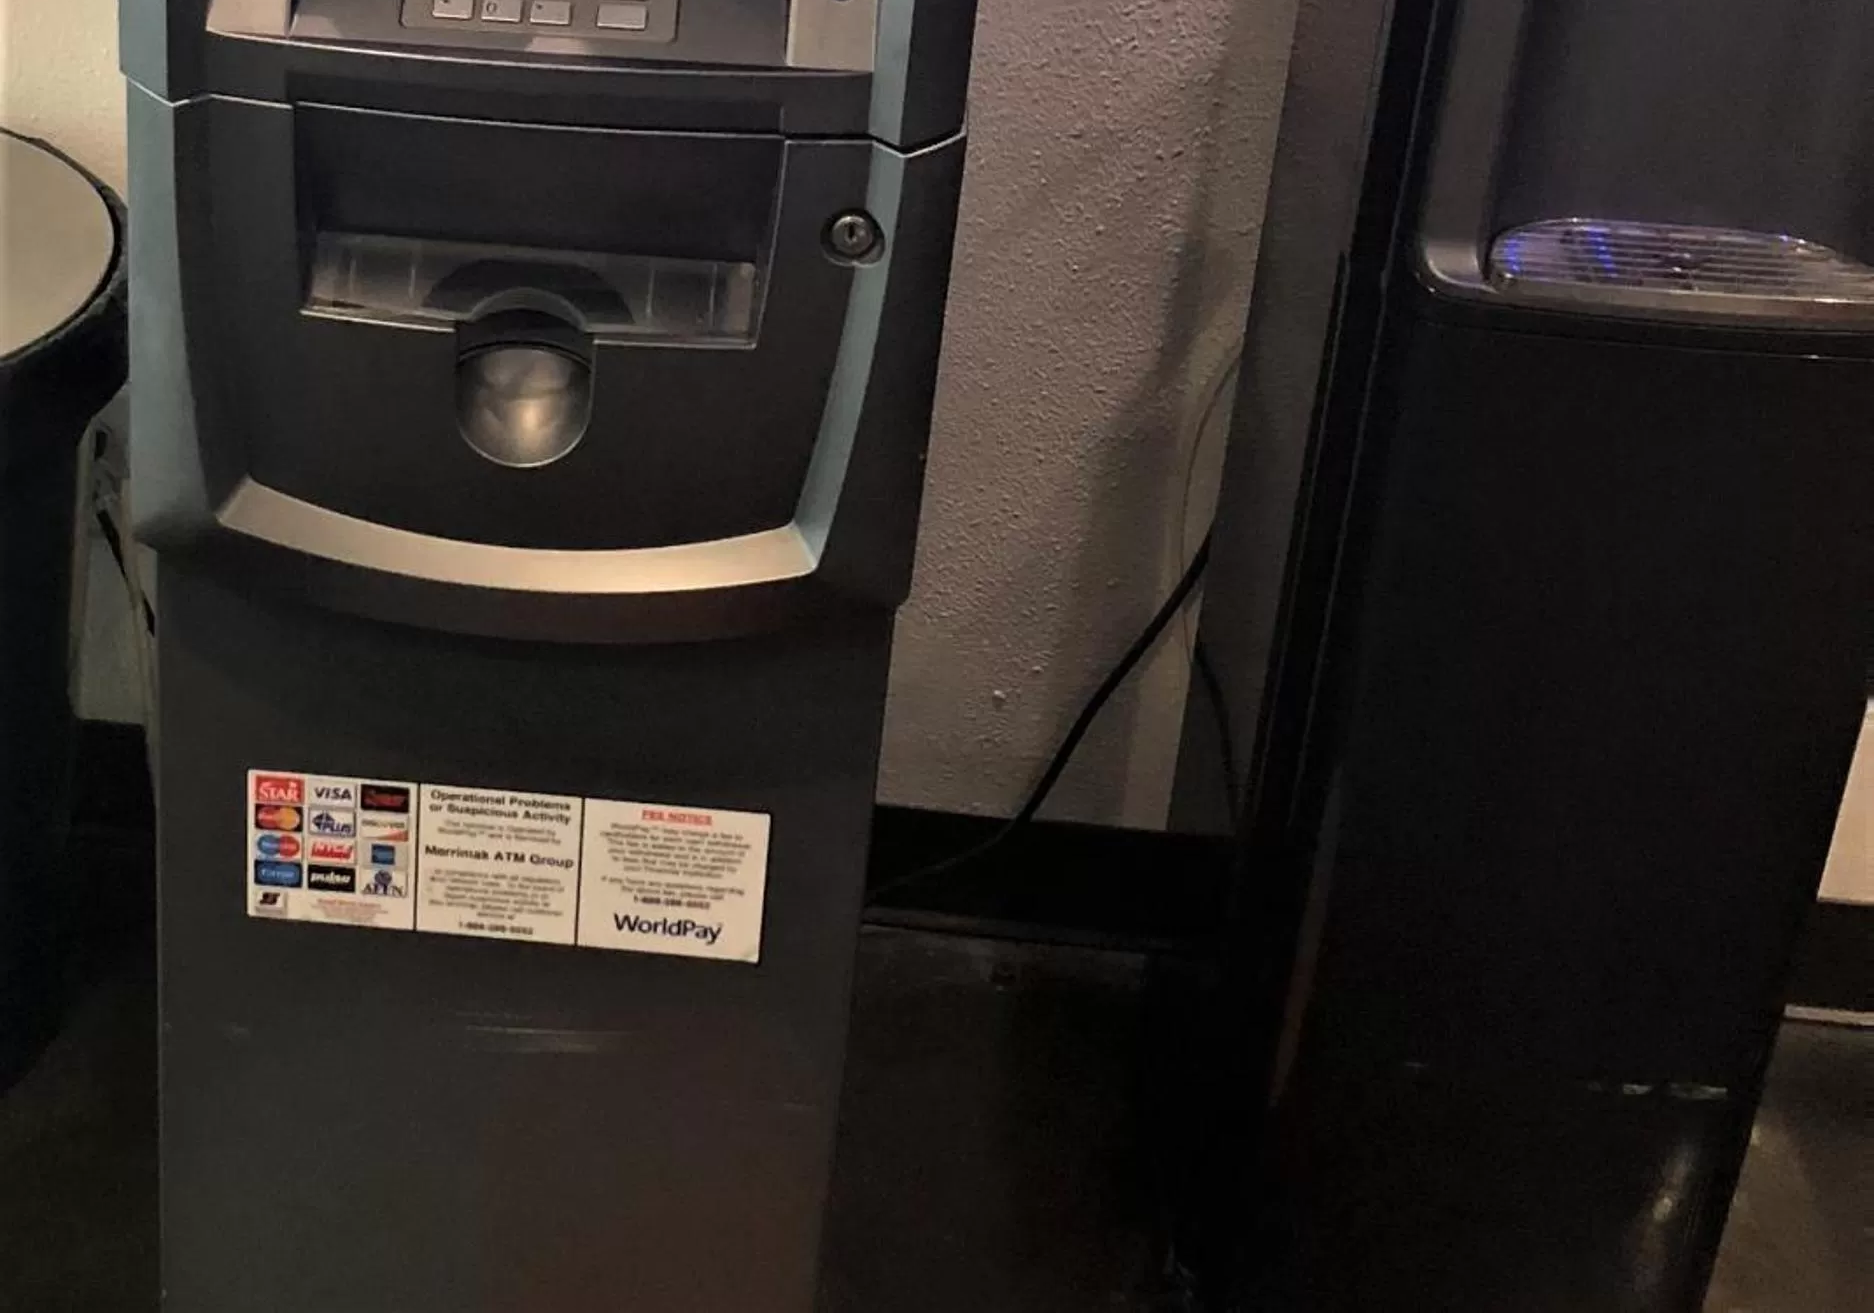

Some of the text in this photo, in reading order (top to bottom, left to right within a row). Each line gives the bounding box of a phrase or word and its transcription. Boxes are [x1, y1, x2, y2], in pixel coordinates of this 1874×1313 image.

[486, 0, 498, 15] 0
[258, 782, 300, 801] STAR
[314, 786, 353, 801] VISA
[430, 789, 571, 811] Operational Problems
[429, 803, 571, 826] or Suspicious Activity
[494, 851, 525, 863] ATM
[529, 853, 574, 869] Group
[613, 912, 722, 945] WorldPay
